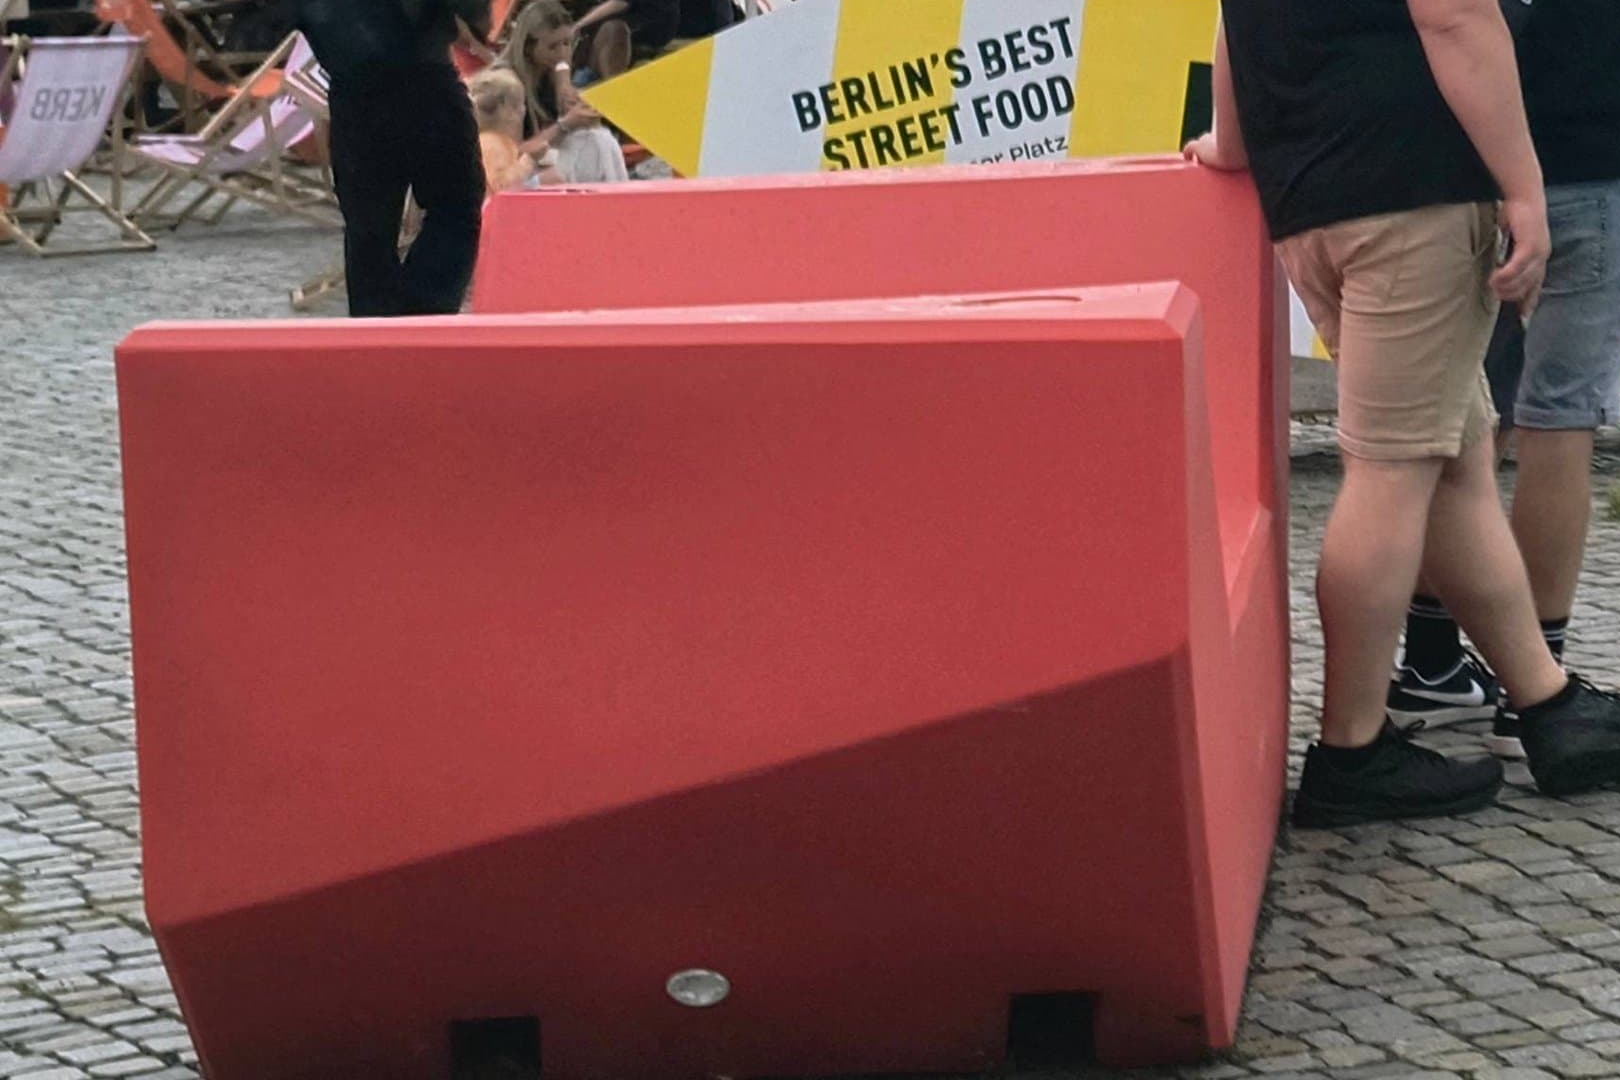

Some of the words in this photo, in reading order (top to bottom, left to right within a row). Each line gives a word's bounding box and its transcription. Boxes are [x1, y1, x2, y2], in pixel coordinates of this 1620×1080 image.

[977, 16, 1074, 81] BEST
[823, 104, 962, 171] STREET
[971, 75, 1075, 137] FOOD
[1010, 136, 1069, 162] Platz
